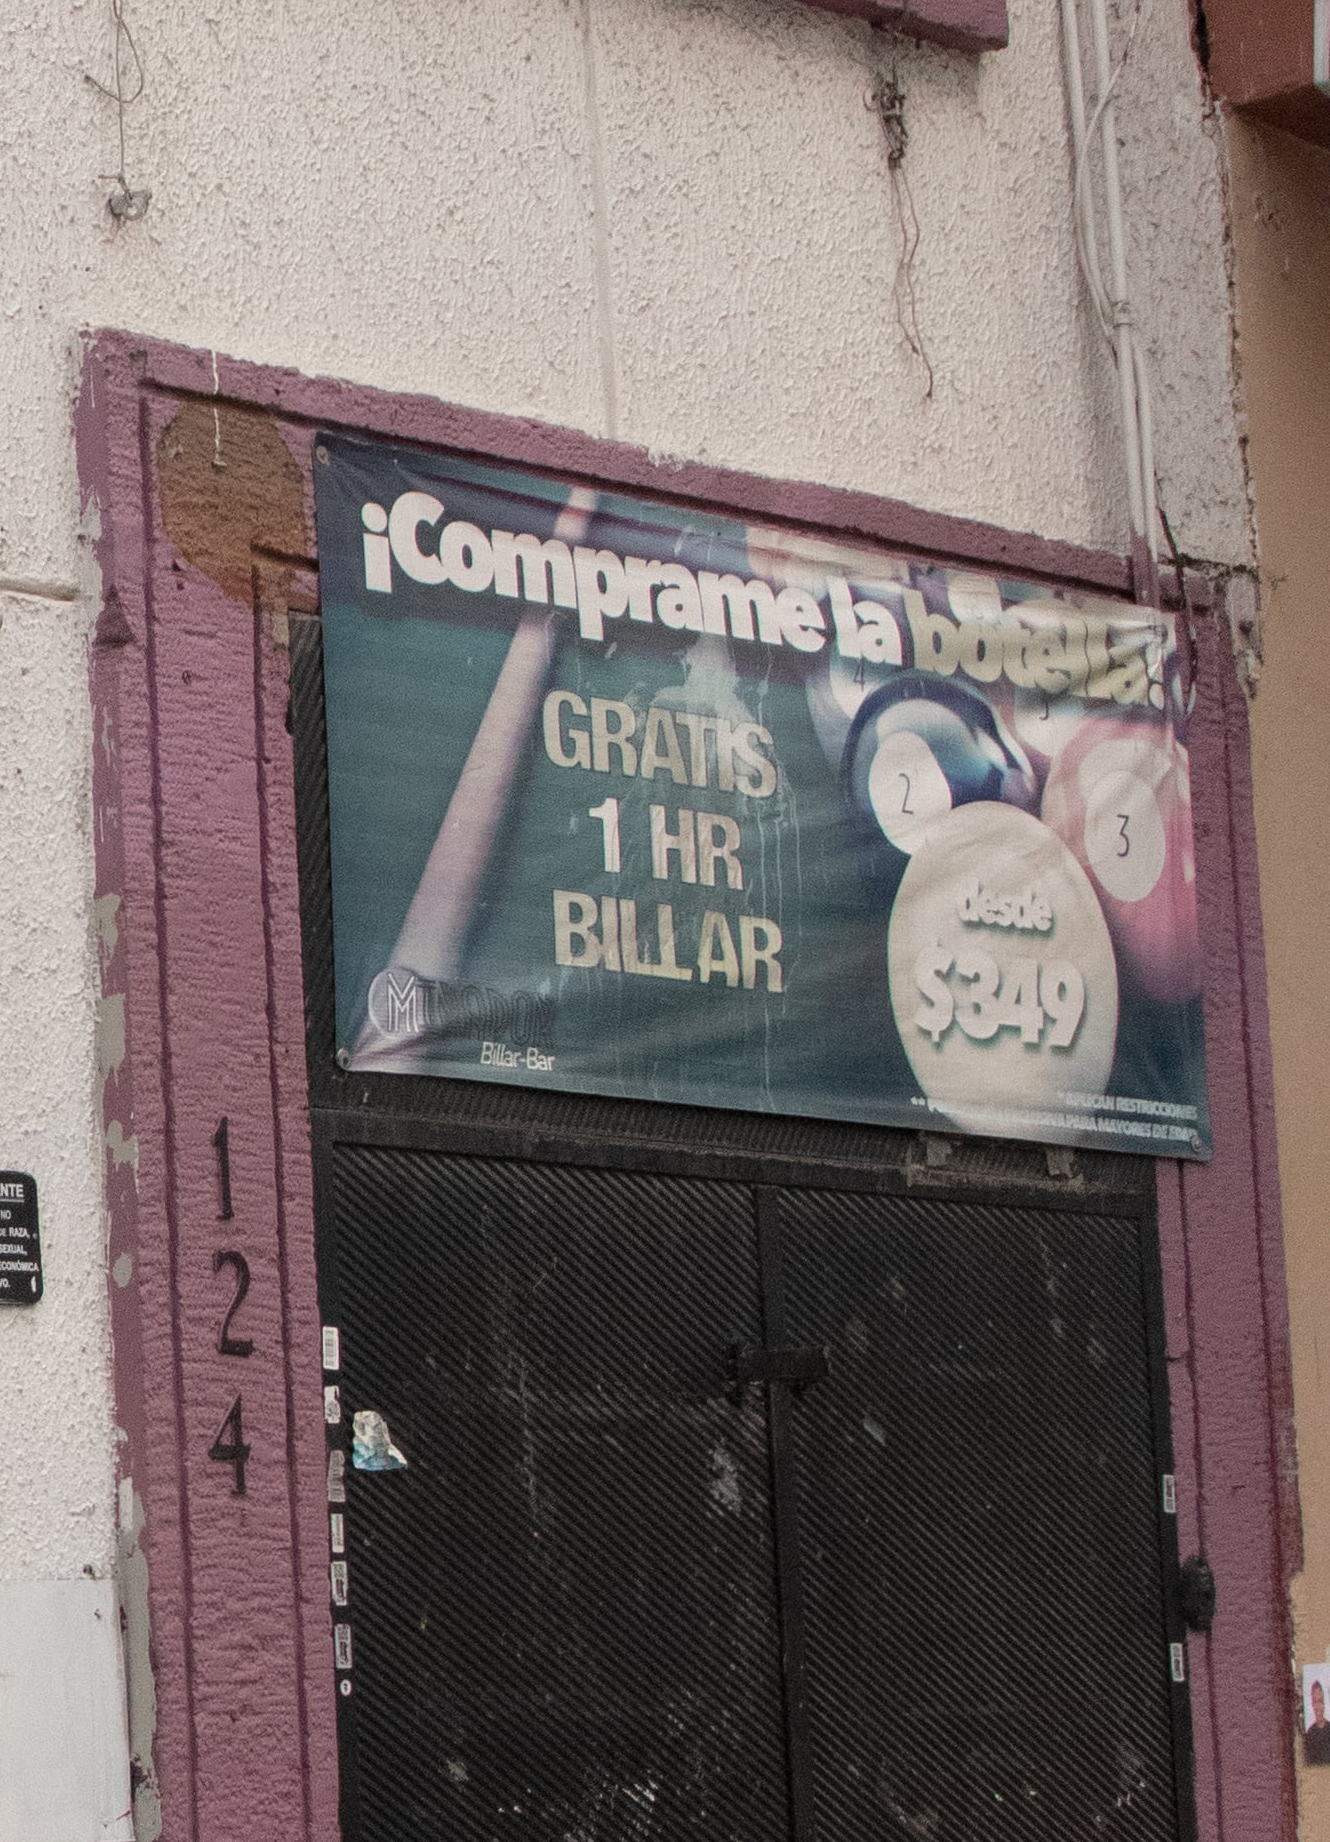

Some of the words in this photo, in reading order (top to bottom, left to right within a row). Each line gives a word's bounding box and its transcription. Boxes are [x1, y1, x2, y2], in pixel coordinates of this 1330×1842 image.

[827, 575, 902, 665] la
[543, 690, 778, 799] GRATIS
[898, 772, 915, 816] 2
[589, 797, 621, 874] 1
[648, 803, 744, 890] HR
[1116, 813, 1131, 858] 3
[552, 888, 783, 994] BILLAR
[957, 877, 1055, 937] desde
[913, 944, 1086, 1049] $349
[479, 1041, 556, 1072] Billar-Bar
[0, 1209, 12, 1220] NO
